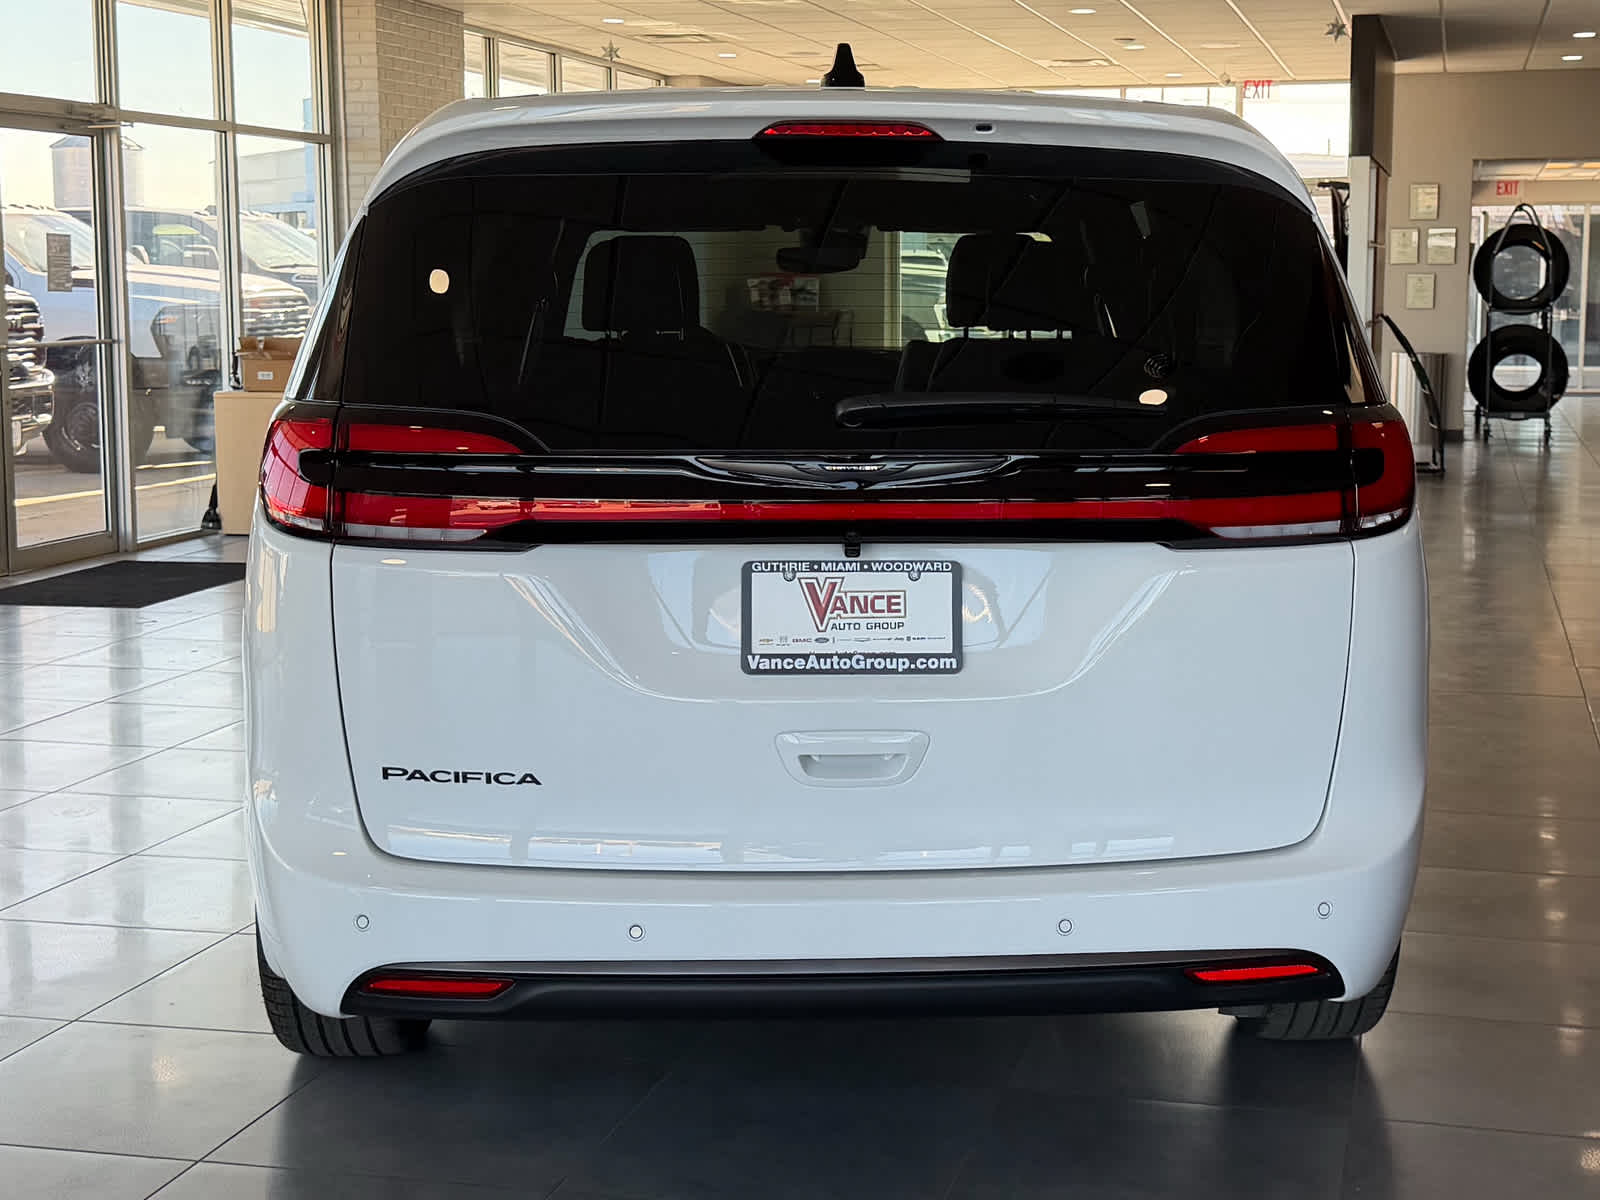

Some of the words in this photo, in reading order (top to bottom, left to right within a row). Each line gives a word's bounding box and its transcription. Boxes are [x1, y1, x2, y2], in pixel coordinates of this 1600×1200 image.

[1243, 80, 1272, 99] EXIT
[1496, 180, 1519, 196] EXIT
[751, 562, 810, 572] GUTHRIE
[820, 562, 861, 571] MIAMI
[871, 562, 952, 571] WOODWARD
[799, 577, 904, 630] VANCE
[831, 623, 861, 631] AUTO
[866, 622, 904, 630] GROUP
[747, 654, 957, 672] VanceAutoGroup.com
[382, 766, 542, 786] PACIFICA
